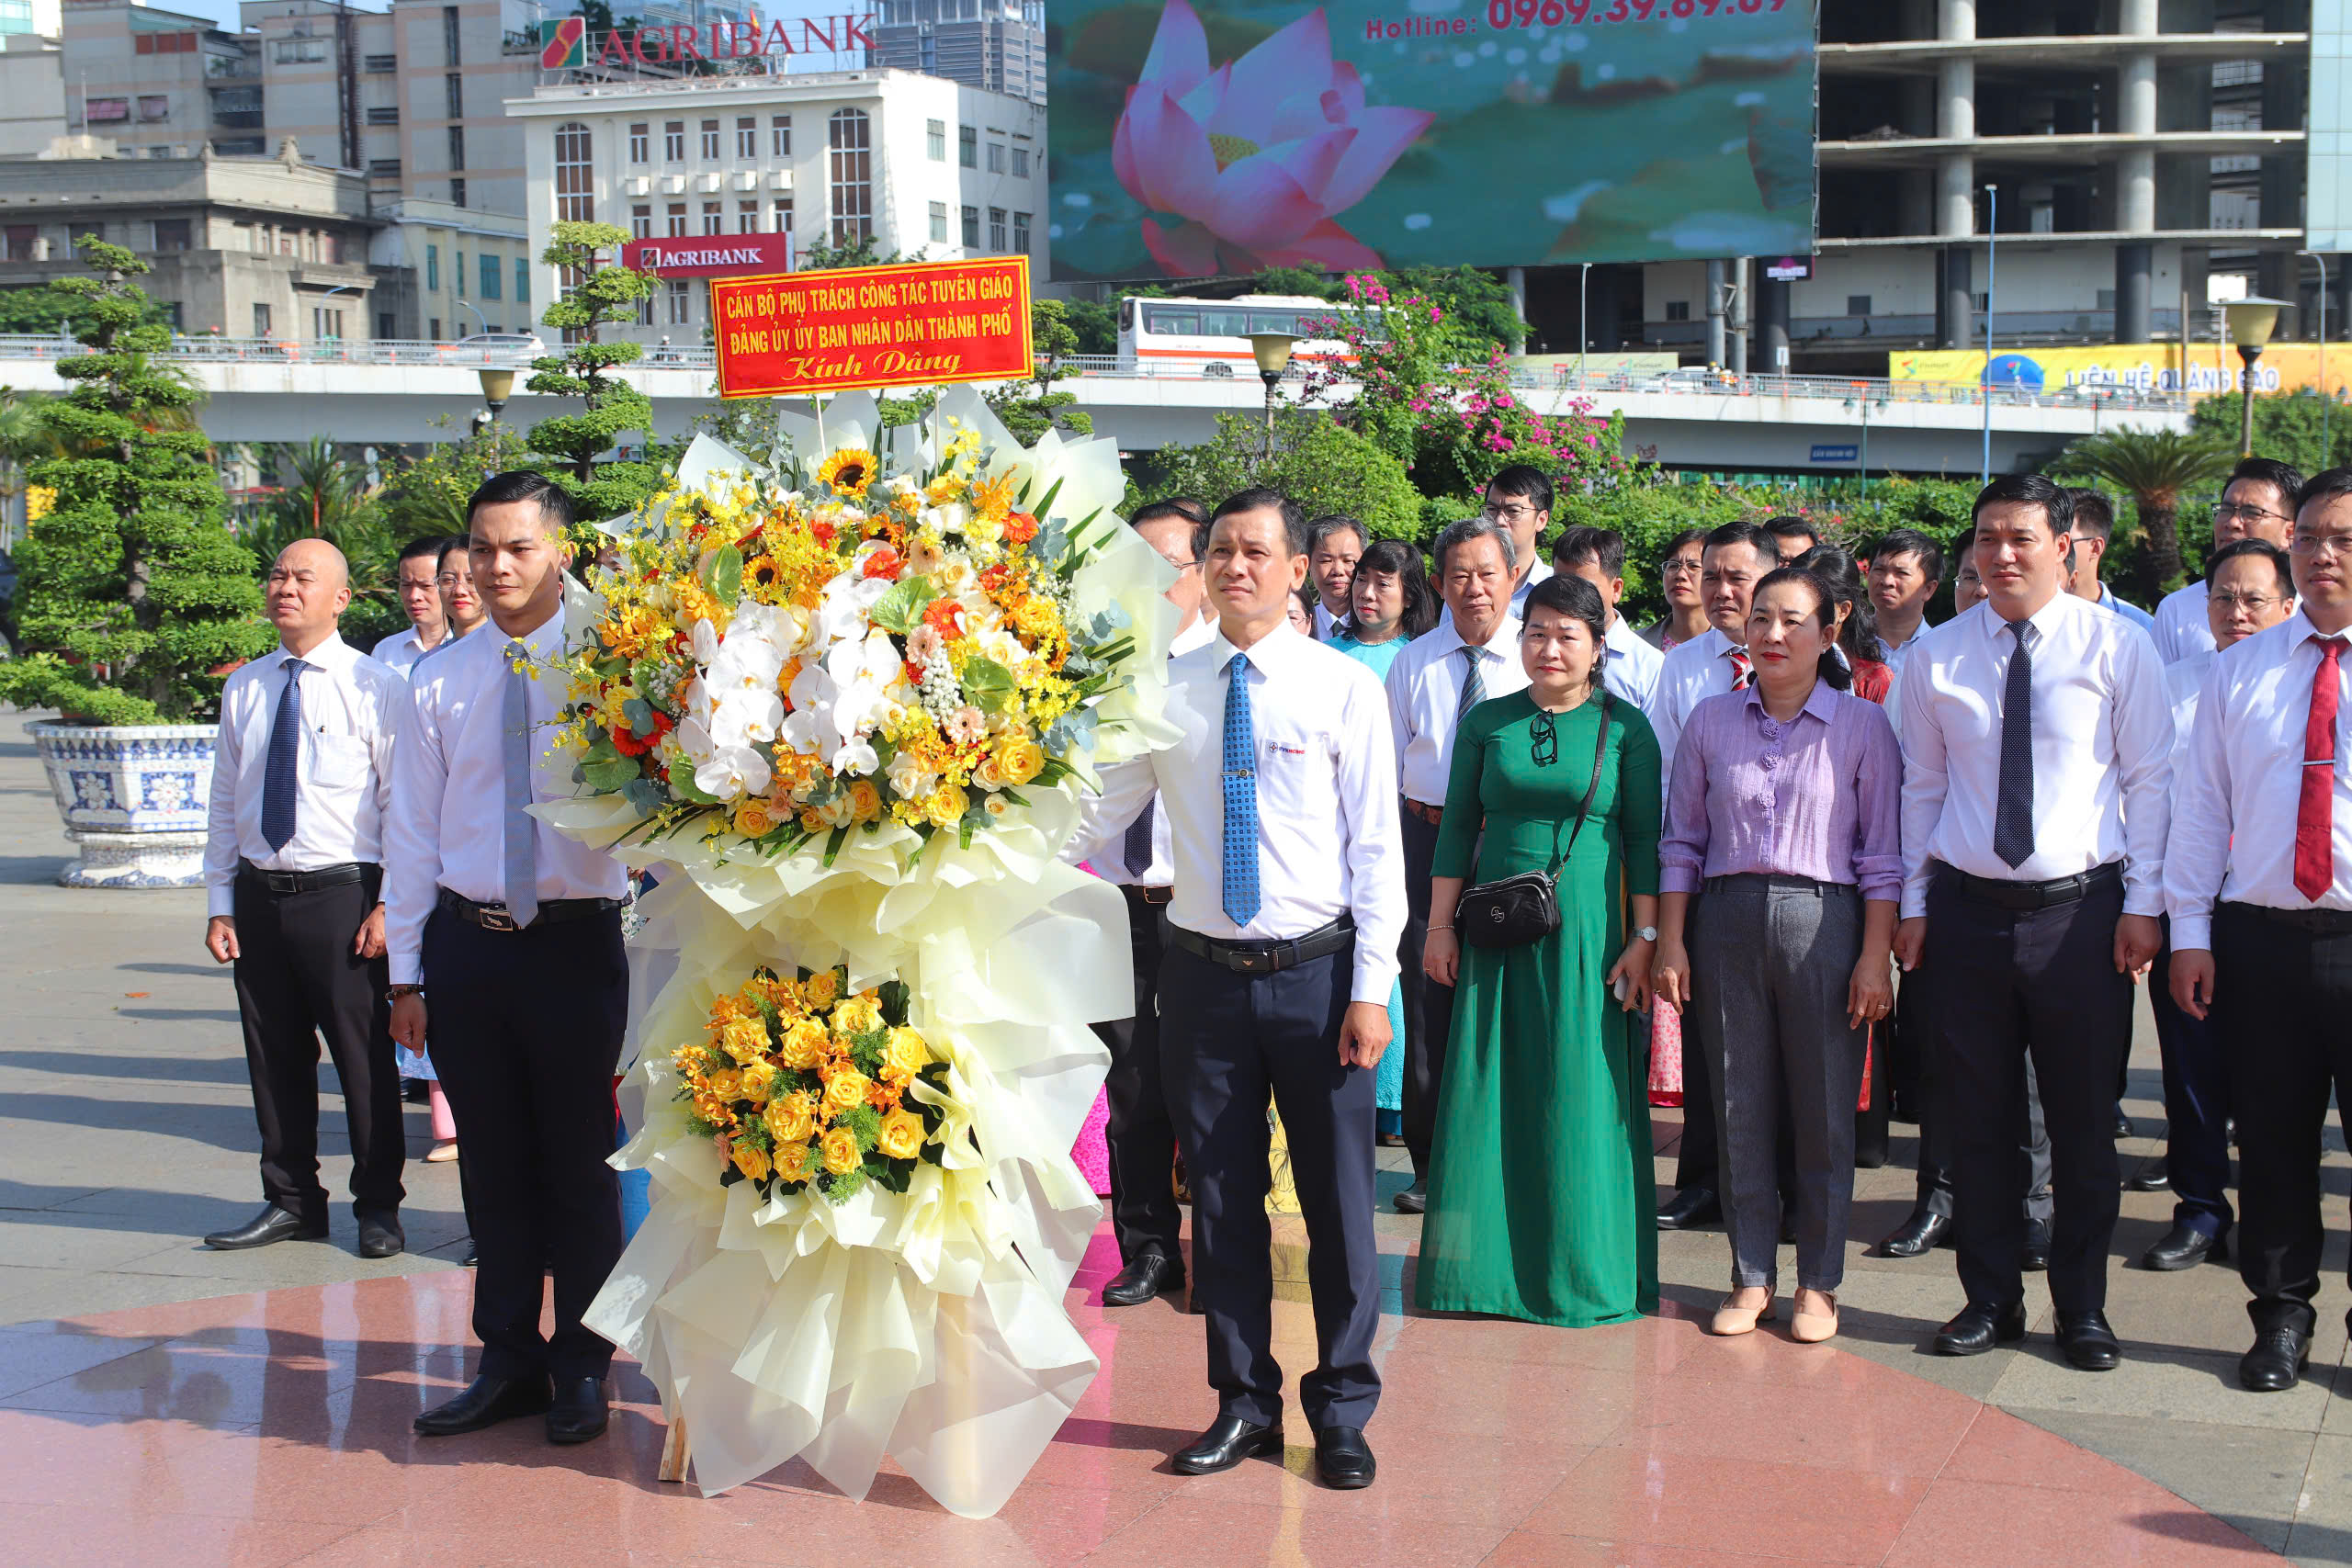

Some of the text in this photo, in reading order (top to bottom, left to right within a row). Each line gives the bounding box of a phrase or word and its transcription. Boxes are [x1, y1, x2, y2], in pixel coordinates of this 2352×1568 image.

[597, 14, 879, 65] AGRIBANK
[1366, 16, 1477, 39] Hotline:
[662, 247, 764, 268] AGRIBANK
[726, 271, 1013, 321] CÁN BỘ PHỤ TRÁCH CÔNG TÁC TUYÊN GIÁO
[729, 303, 1012, 355] ĐẢNG ỦY ỦY BAN NHÂN DÂN THÀNH PHỐ
[781, 350, 963, 380] Kính Dâng
